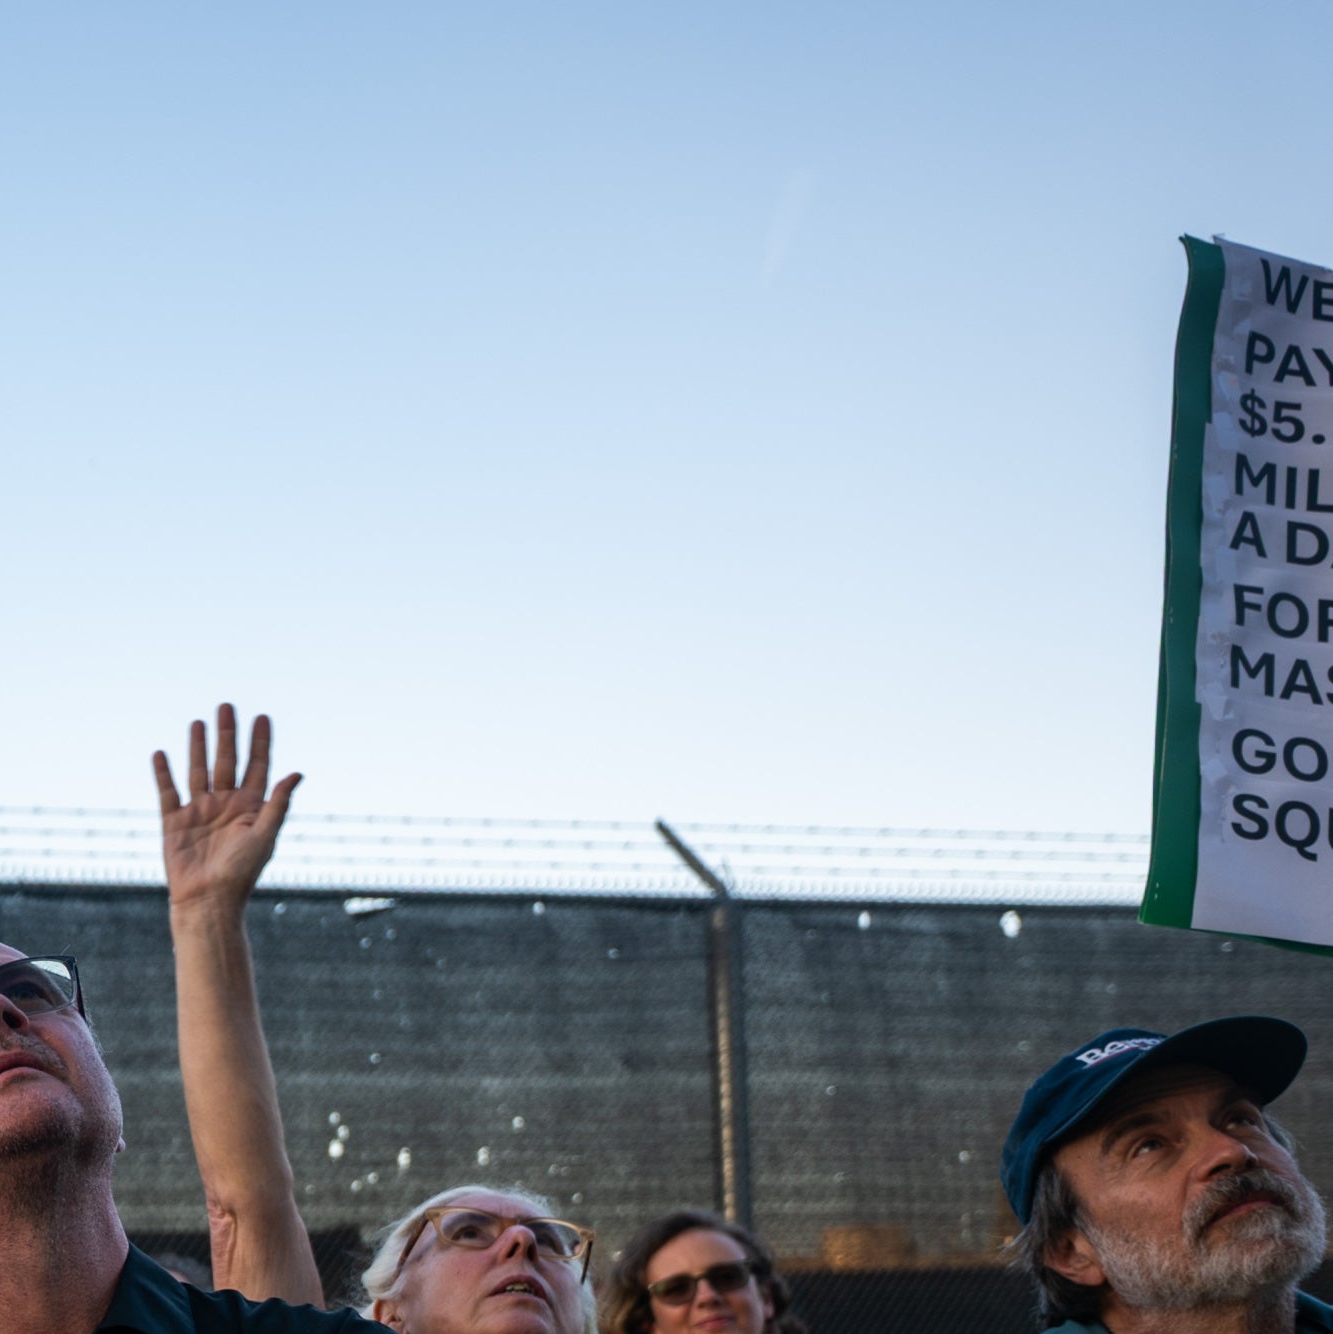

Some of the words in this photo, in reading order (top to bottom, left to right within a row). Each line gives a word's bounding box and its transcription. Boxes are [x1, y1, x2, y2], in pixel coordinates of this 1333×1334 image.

[1260, 258, 1333, 322] WE
[1238, 388, 1326, 444] $5.
[1235, 452, 1333, 513] MIL
[1229, 510, 1268, 559] A
[1286, 520, 1333, 569] D
[1230, 643, 1333, 706] MA
[1232, 728, 1328, 782] GO
[1231, 793, 1333, 862] SQ
